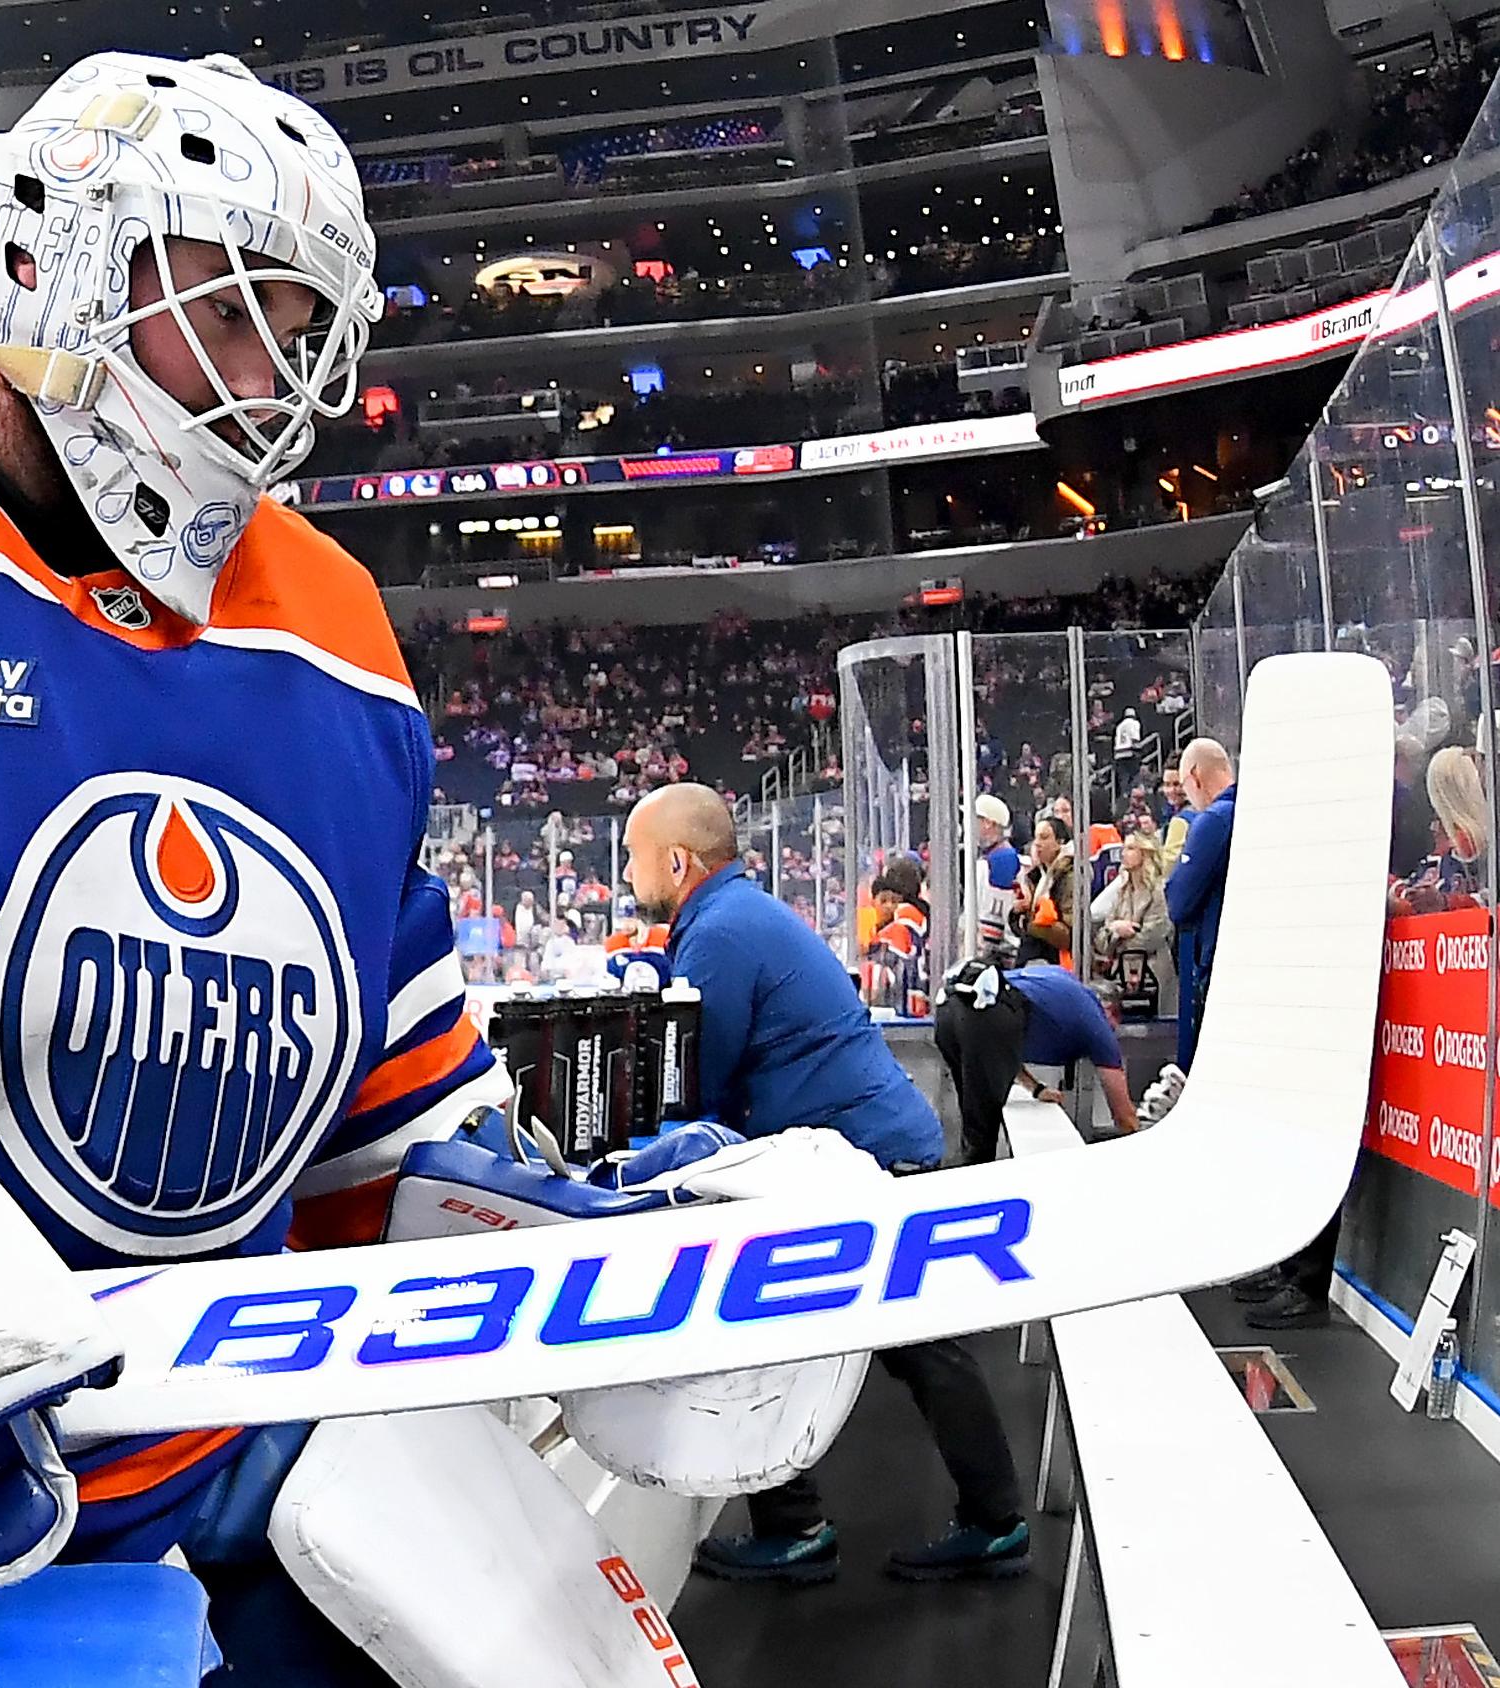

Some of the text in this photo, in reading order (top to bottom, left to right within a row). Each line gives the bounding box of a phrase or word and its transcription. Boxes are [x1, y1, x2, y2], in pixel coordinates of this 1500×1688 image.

[344, 58, 388, 88] IS
[408, 47, 484, 77] OIL
[504, 13, 758, 65] COUNTRY
[1321, 308, 1373, 338] Brandt
[110, 598, 135, 619] NHL
[1391, 937, 1426, 971] ROGERS
[1446, 934, 1489, 970] ROGERS
[1390, 1024, 1425, 1059] ROGERS
[1445, 1030, 1487, 1071] ROGERS
[47, 926, 317, 1212] OILERS
[574, 1037, 592, 1151] BODYARMOR
[1387, 1105, 1420, 1146] ROGERS
[1441, 1122, 1483, 1170] ROGERS
